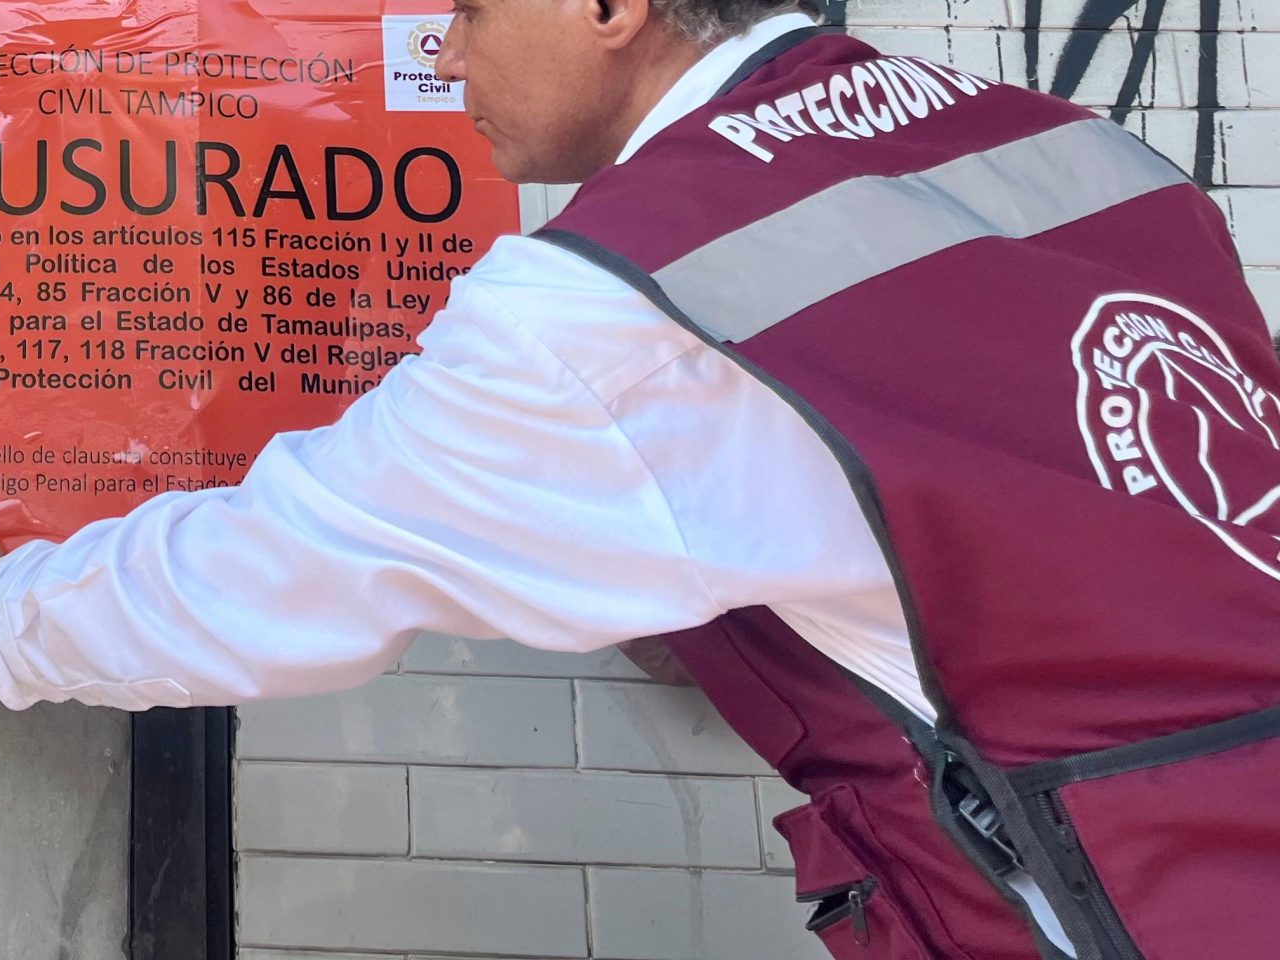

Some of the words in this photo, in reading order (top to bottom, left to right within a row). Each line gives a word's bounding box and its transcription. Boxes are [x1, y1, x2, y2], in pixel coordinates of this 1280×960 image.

[116, 51, 153, 76] DE
[165, 51, 354, 84] PROTECCIÓN
[416, 95, 456, 104] Tampico
[418, 83, 451, 93] Civil
[38, 89, 112, 115] CIVIL
[122, 90, 258, 119] TAMPICO
[10, 231, 40, 246] en
[49, 226, 84, 246] los
[93, 226, 203, 247] artículos
[212, 228, 256, 248] 115
[265, 229, 370, 253] Fracción
[381, 232, 387, 252] I
[395, 237, 409, 258] y
[418, 233, 433, 253] II
[442, 234, 473, 253] de
[26, 253, 117, 275] Política
[143, 255, 174, 275] de
[200, 255, 235, 276] los
[261, 257, 360, 280] Estados
[386, 261, 472, 282] Unidos
[37, 283, 67, 303] 85
[81, 283, 190, 304] Fracción
[205, 283, 222, 303] V
[235, 289, 249, 308] y
[263, 286, 292, 306] 86
[306, 287, 337, 307] de
[350, 288, 372, 309] la
[386, 289, 431, 314] Ley
[9, 315, 67, 335] para
[81, 311, 102, 331] el
[116, 311, 204, 332] Estado
[217, 313, 248, 333] de
[261, 314, 412, 341] Tamaulipas,
[17, 339, 68, 363] 117,
[81, 339, 126, 360] 118
[135, 340, 245, 363] Fracción
[254, 343, 271, 362] V
[281, 344, 317, 364] del
[158, 369, 213, 390] Civil
[238, 371, 275, 392] del
[1093, 313, 1176, 496] PROTECCION
[32, 446, 55, 464] de
[63, 446, 142, 465] clausura
[149, 447, 247, 470] constituye
[36, 473, 87, 492] Penal
[94, 478, 137, 496] para
[143, 474, 160, 492] el
[166, 475, 229, 492] Estado
